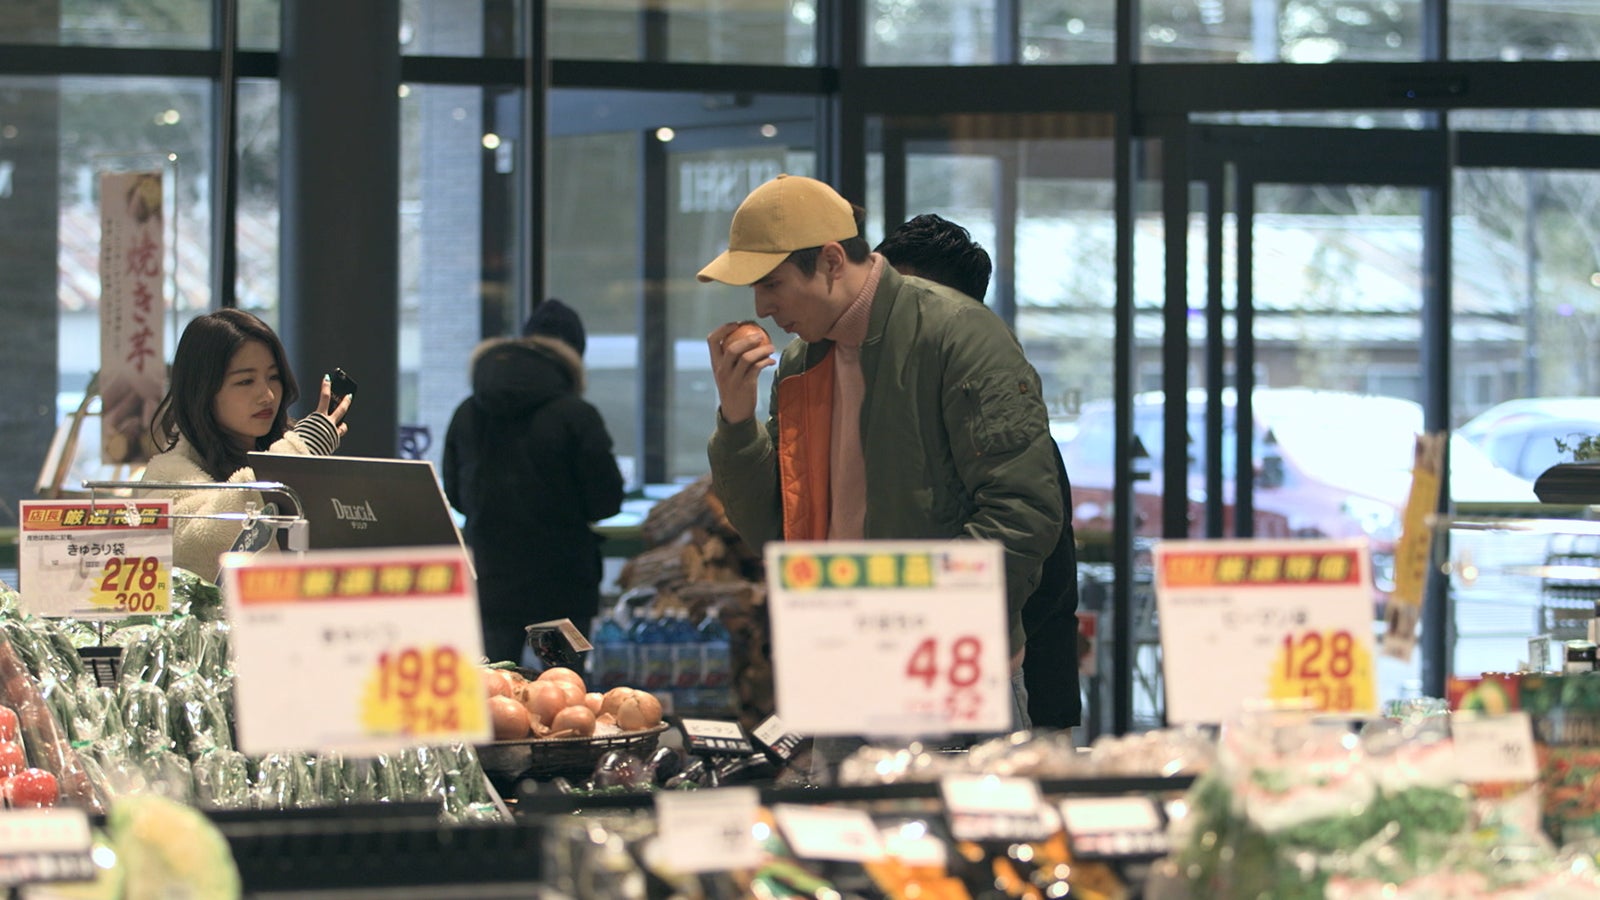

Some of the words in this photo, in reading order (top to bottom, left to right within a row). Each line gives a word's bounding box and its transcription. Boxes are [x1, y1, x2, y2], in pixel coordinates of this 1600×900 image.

[126, 229, 161, 374] 焼き芋
[67, 543, 125, 556] きゅうり袋
[101, 556, 159, 591] 278
[114, 592, 156, 612] 300
[377, 645, 460, 702] 198
[905, 635, 983, 688] 48
[1283, 630, 1354, 680] 128
